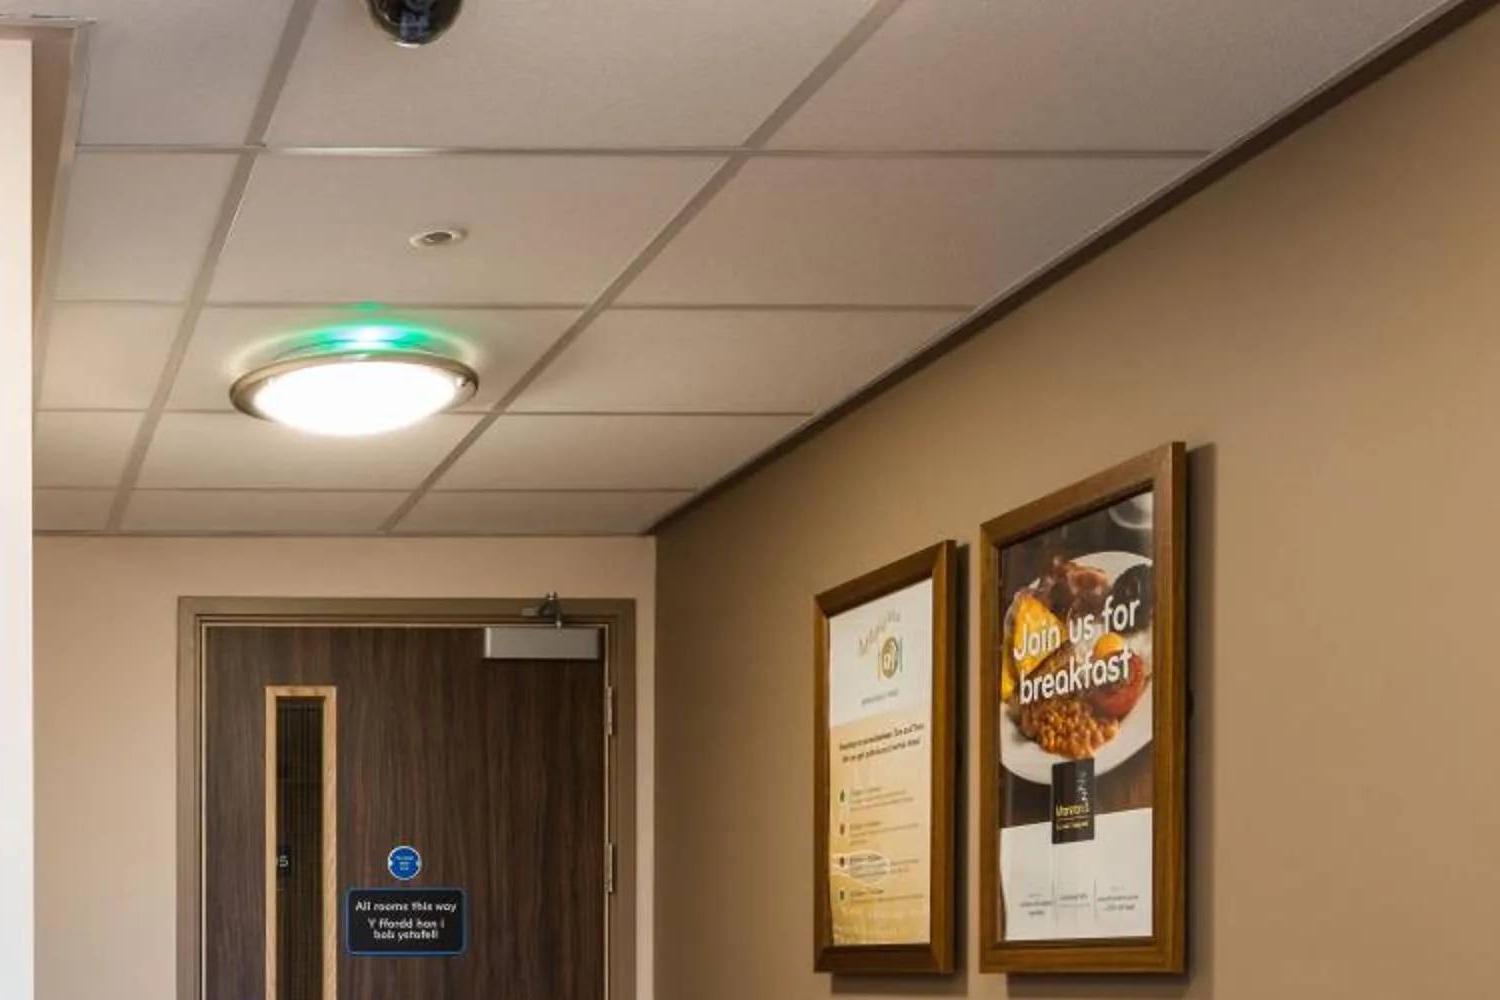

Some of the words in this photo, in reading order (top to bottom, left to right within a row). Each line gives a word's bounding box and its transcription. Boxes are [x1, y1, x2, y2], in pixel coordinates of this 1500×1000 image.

[1013, 622, 1061, 661] Join
[1069, 613, 1095, 644] us
[1102, 595, 1140, 634] for
[1020, 643, 1132, 704] breakfast
[355, 901, 371, 911] All
[373, 902, 409, 911] rooms
[411, 901, 433, 911] this
[435, 903, 457, 913] way
[367, 918, 377, 929] Y
[379, 918, 413, 929] ffordd
